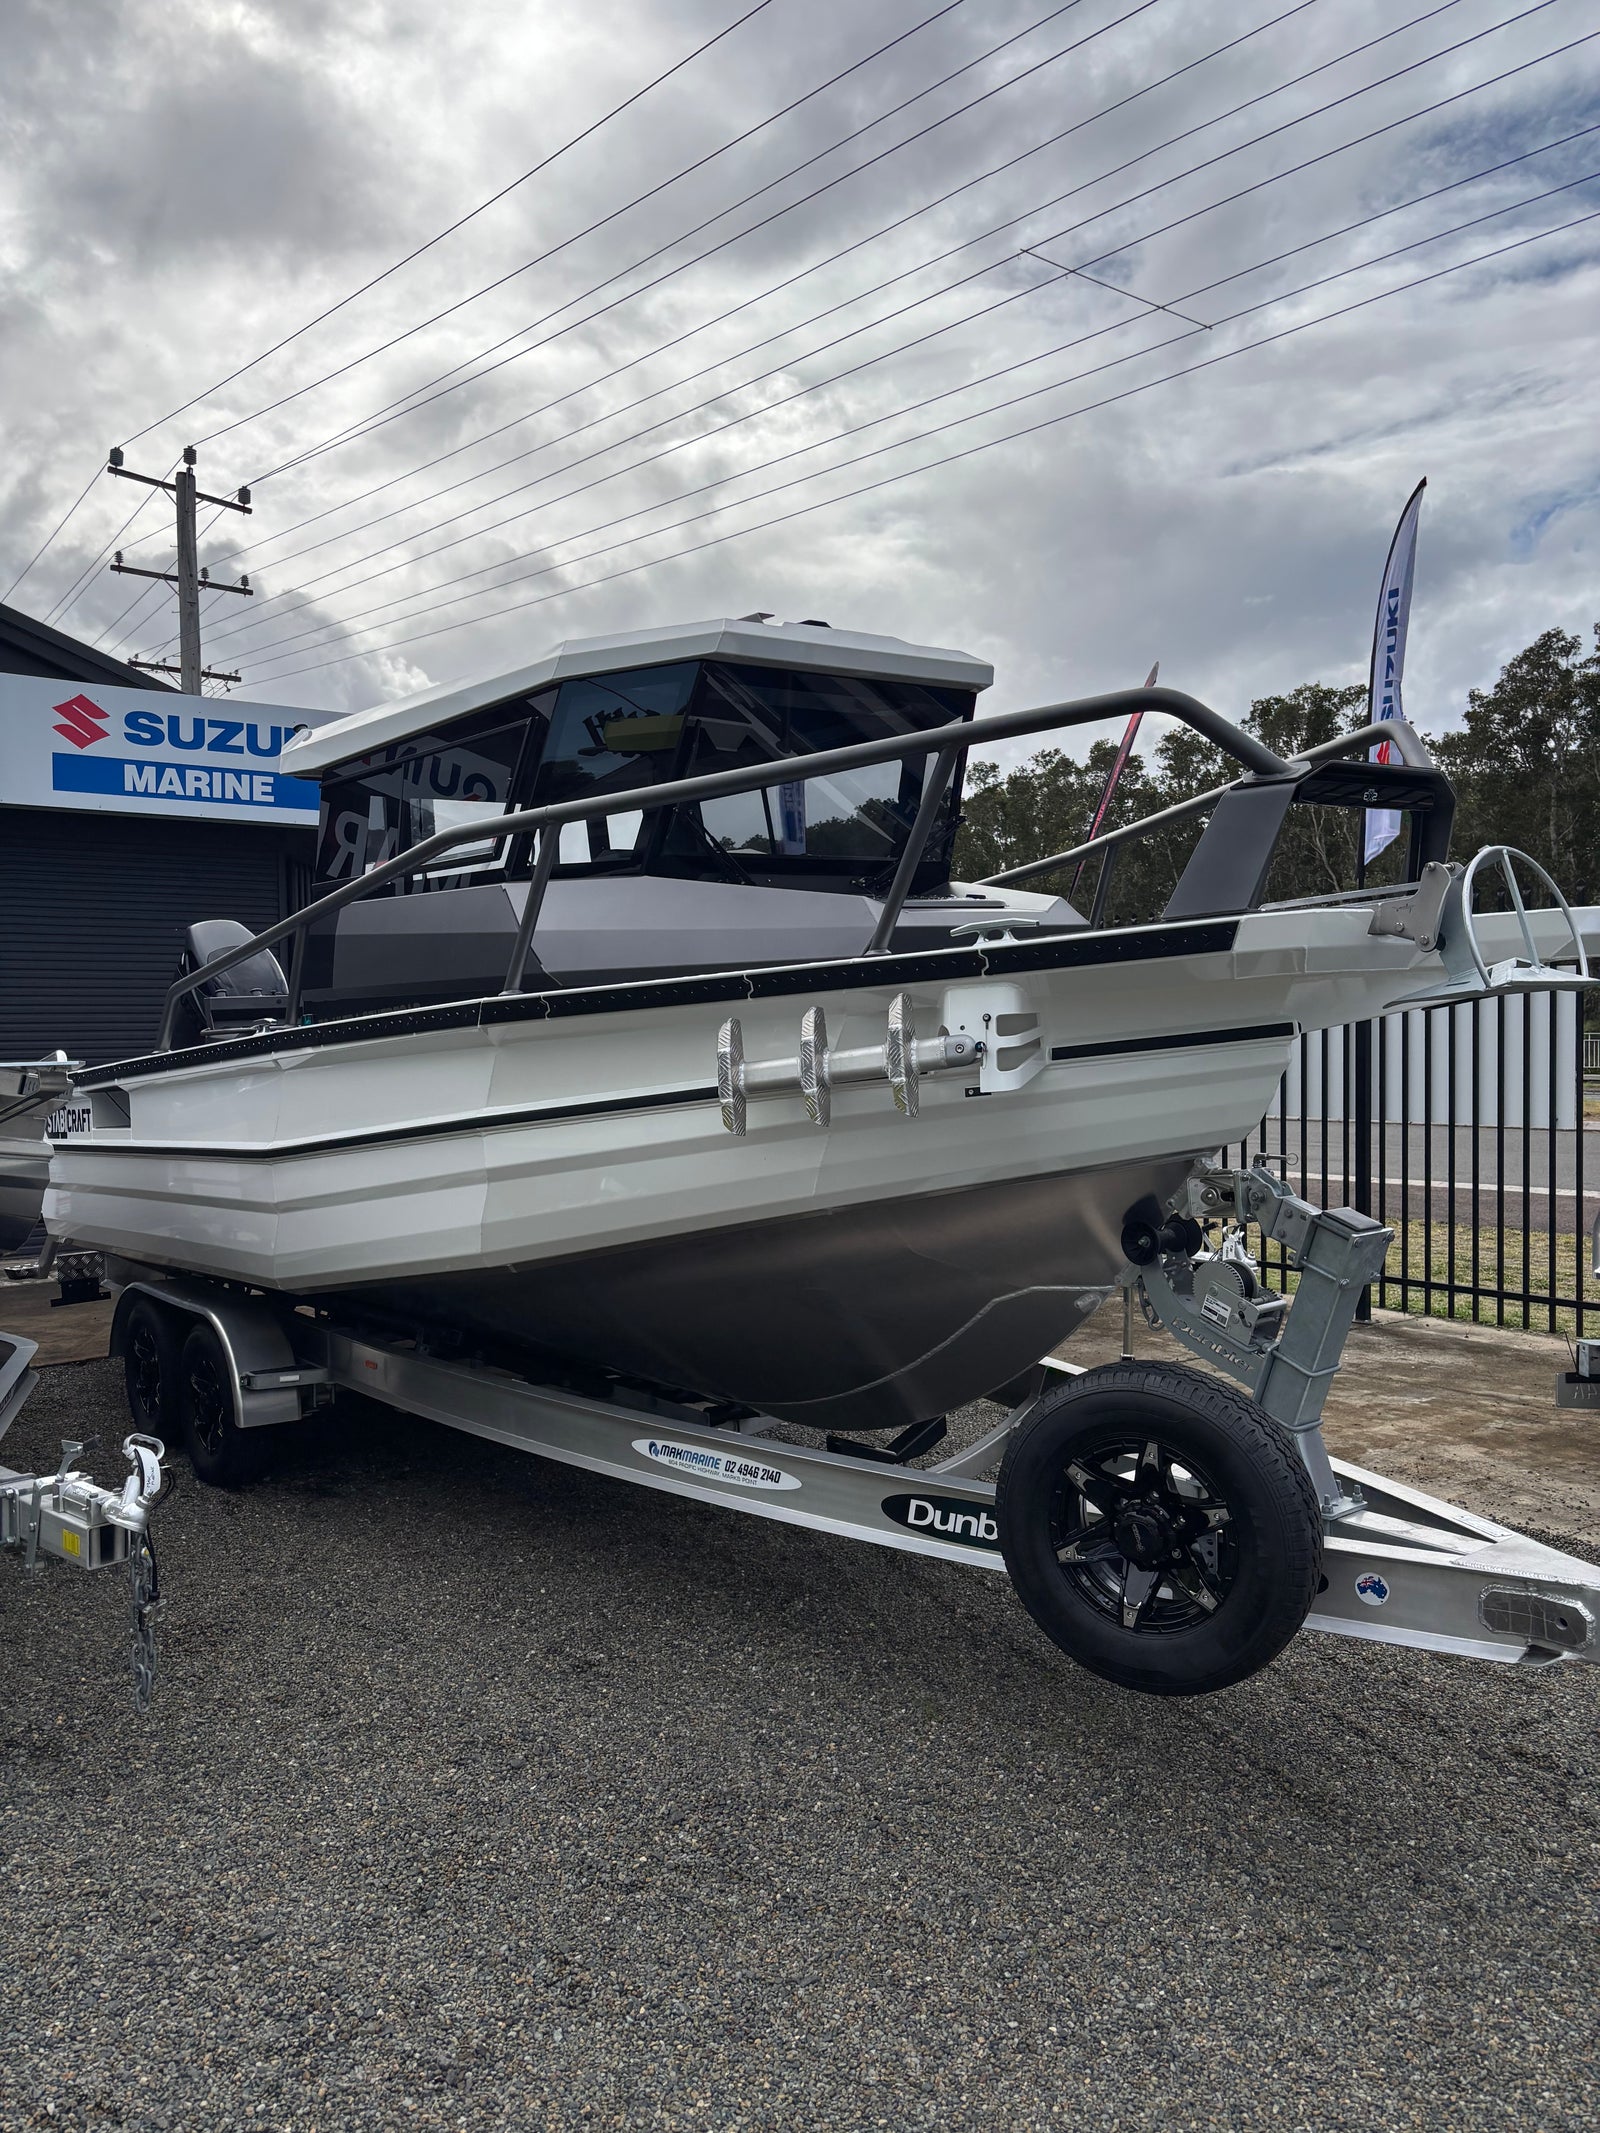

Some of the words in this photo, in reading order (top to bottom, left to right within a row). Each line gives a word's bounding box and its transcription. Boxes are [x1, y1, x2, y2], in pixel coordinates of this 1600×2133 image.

[123, 710, 293, 757] SUZU
[123, 764, 275, 803] MARINE
[679, 1462, 697, 1471] PACIFIC
[741, 1477, 757, 1486] POINT
[724, 1460, 737, 1474] 02
[738, 1463, 760, 1479] 4946
[760, 1468, 782, 1484] 2140
